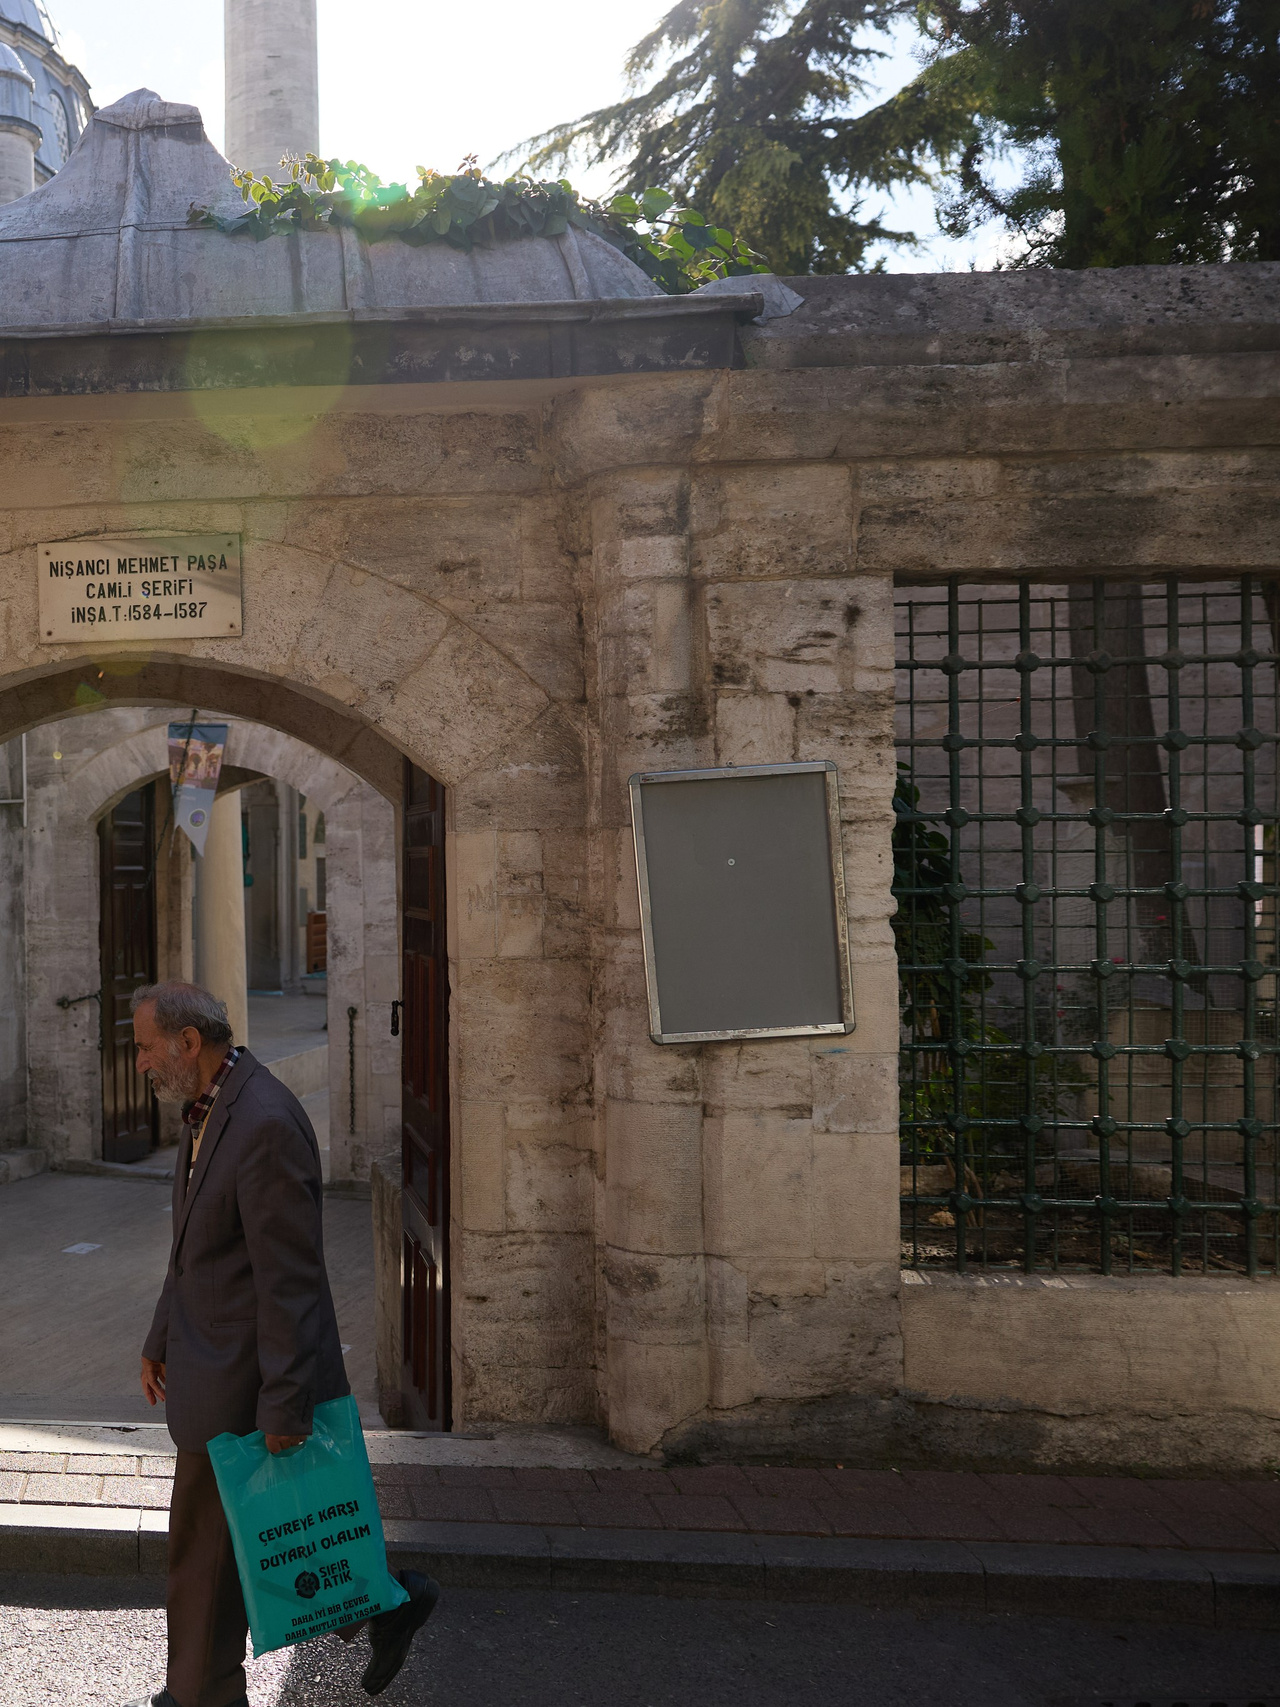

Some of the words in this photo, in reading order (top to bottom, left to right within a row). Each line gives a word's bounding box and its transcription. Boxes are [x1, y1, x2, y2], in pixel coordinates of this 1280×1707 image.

[117, 556, 180, 575] MEHMET
[187, 554, 228, 573] PAŞA
[258, 1513, 315, 1547] ÇEVREYE
[318, 1499, 360, 1523] KARŞI
[260, 1541, 317, 1571] DUYARLI
[320, 1524, 371, 1550] OLALIM
[319, 1559, 350, 1578] SIFIR
[323, 1570, 353, 1590] ATIK
[285, 1628, 308, 1641] DAHA
[308, 1618, 337, 1635] MUTLU
[339, 1613, 353, 1625] BİR
[353, 1603, 381, 1619] YAŞAM
[291, 1613, 314, 1627] DAHA
[314, 1606, 327, 1620] İYİ
[327, 1603, 342, 1615] BİR
[342, 1594, 370, 1611] ÇEVRE
